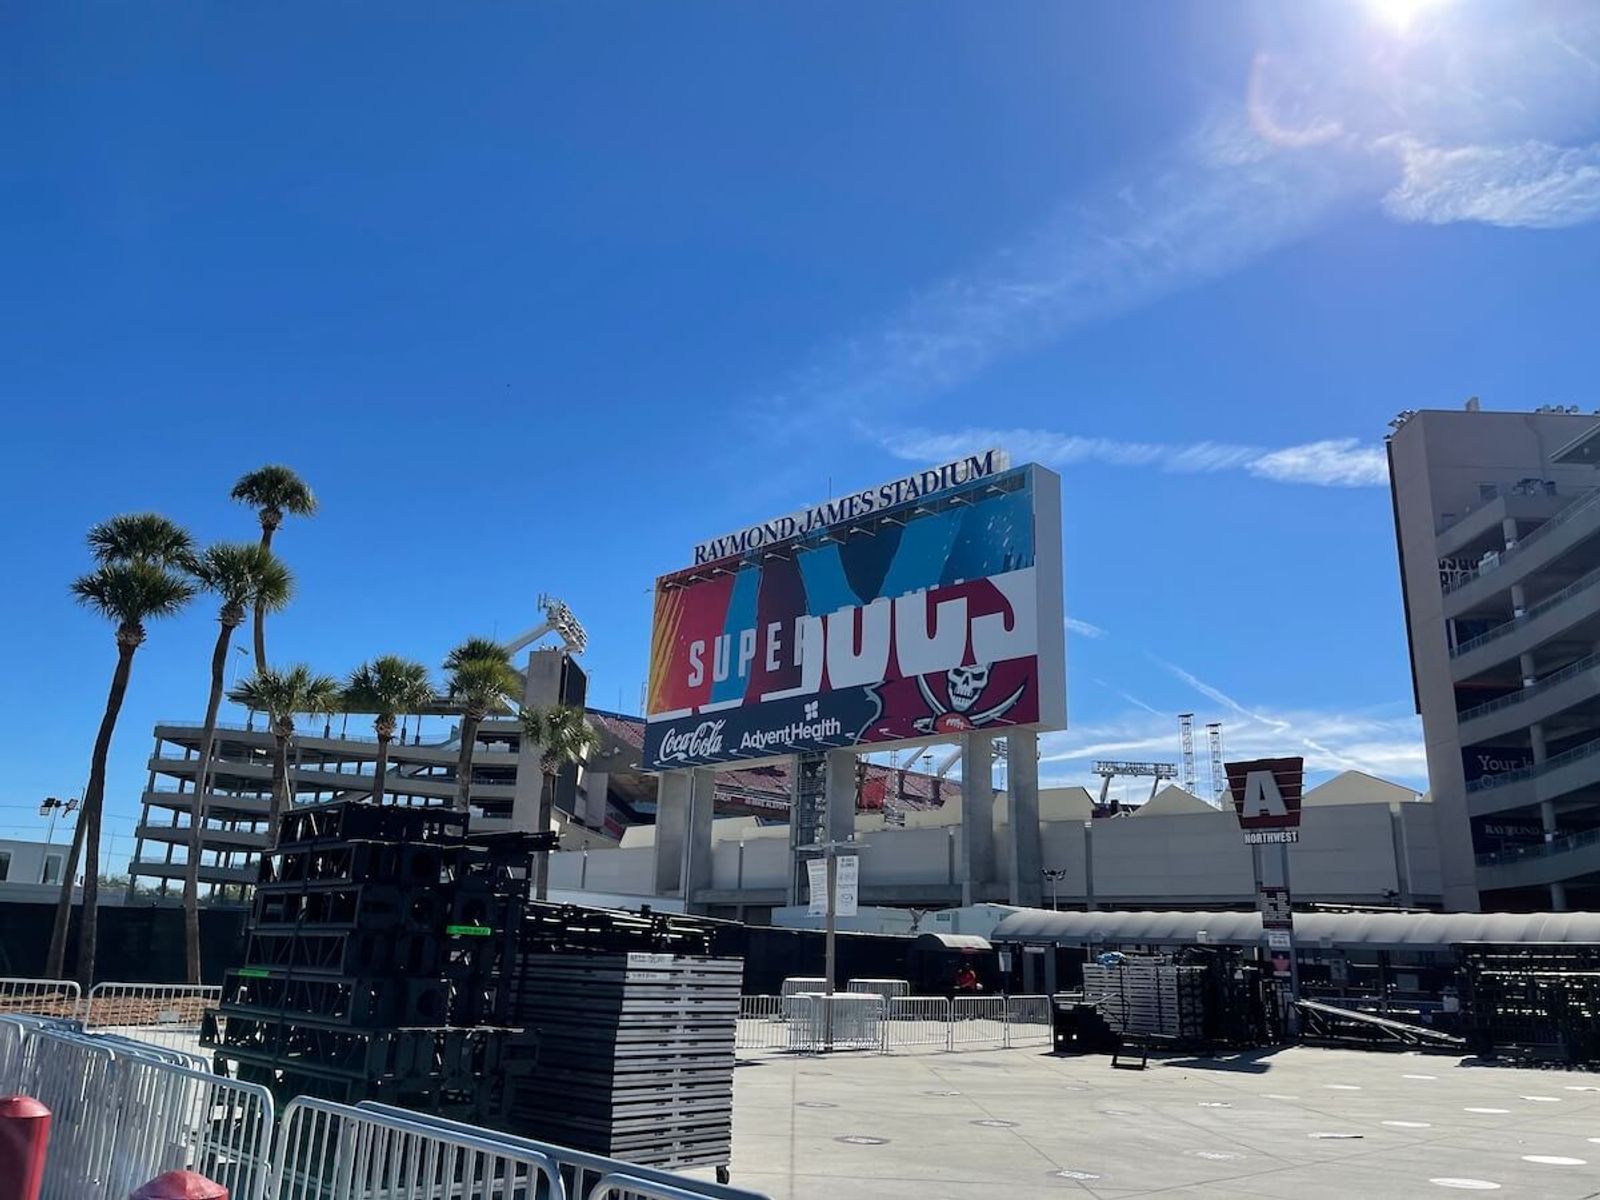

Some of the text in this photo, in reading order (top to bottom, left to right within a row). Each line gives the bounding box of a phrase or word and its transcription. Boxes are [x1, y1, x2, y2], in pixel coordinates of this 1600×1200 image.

[694, 449, 995, 564] RAYMOND JAMES STADIUM
[740, 717, 841, 750] AdventHealth
[1478, 755, 1518, 771] Your
[1243, 770, 1288, 817] A
[1244, 831, 1297, 845] NORTHWEST
